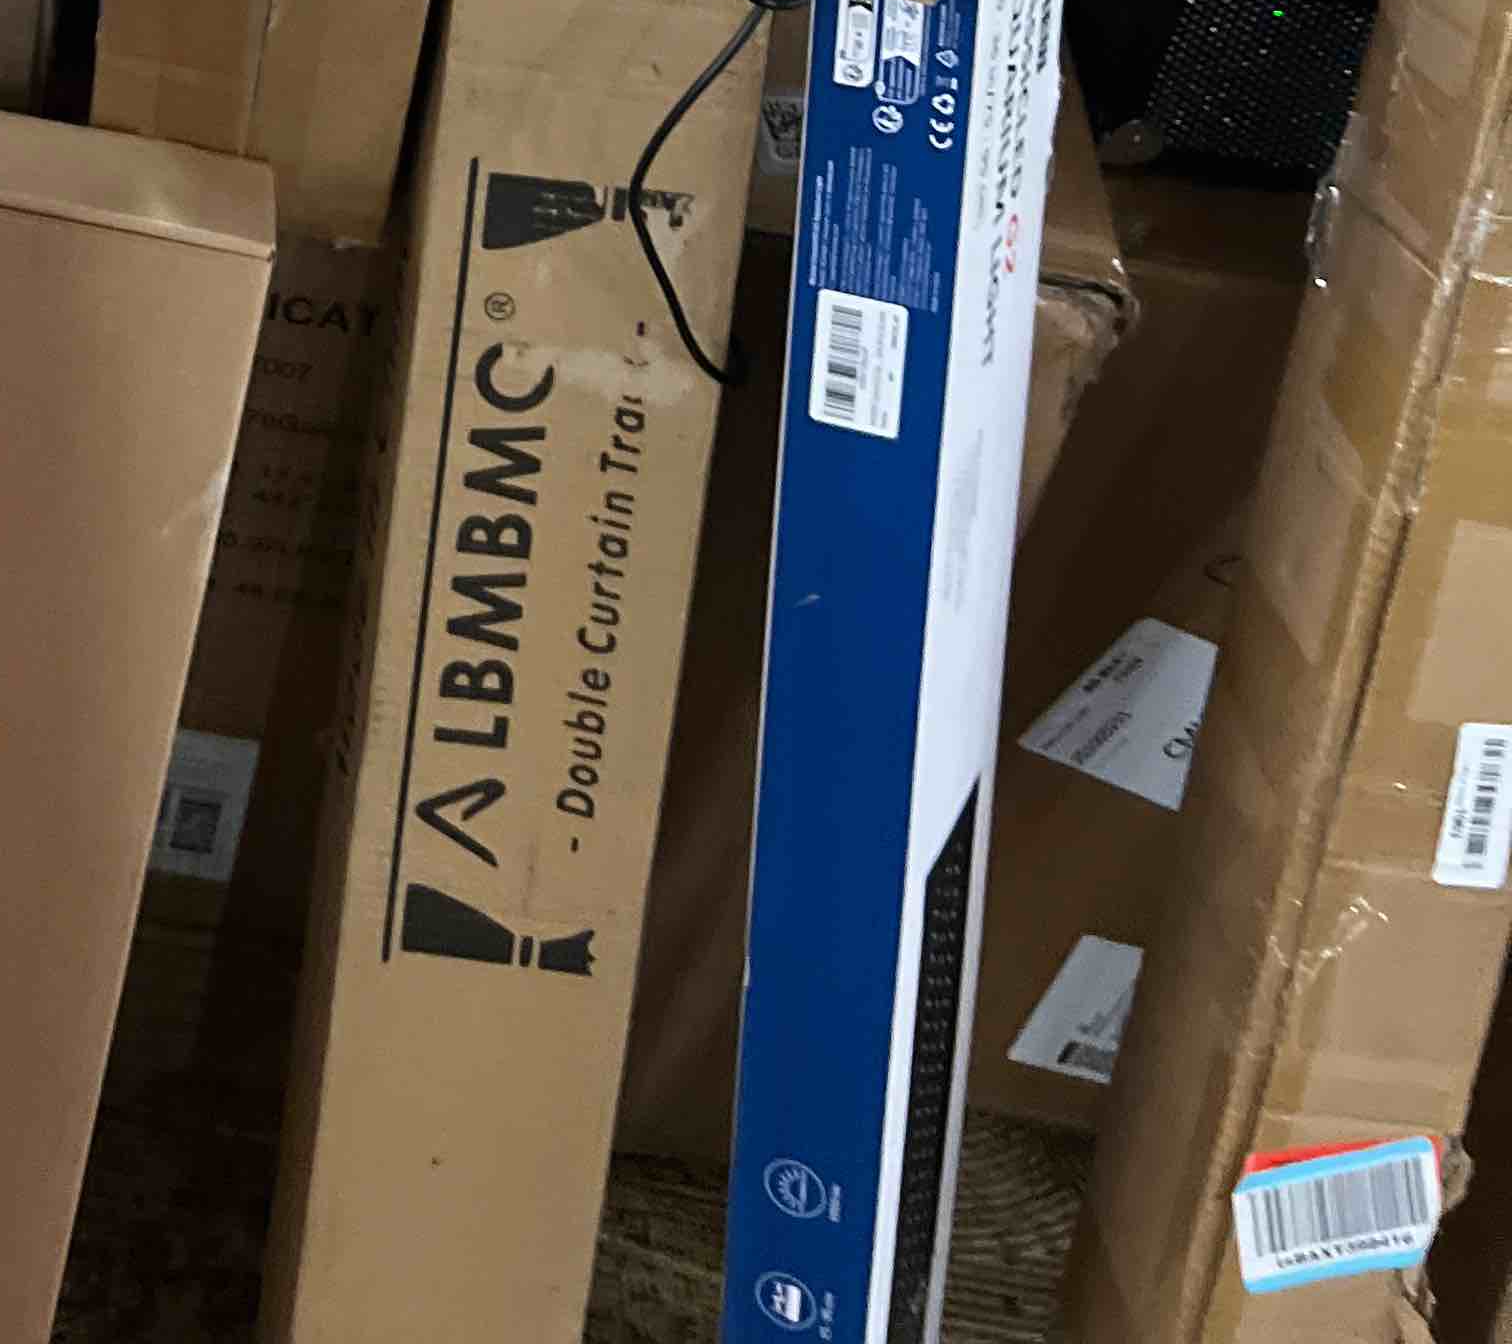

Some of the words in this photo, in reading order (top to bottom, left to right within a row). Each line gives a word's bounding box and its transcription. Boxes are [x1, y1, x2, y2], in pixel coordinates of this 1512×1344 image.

[414, 341, 556, 869] ALBMBMC
[578, 488, 636, 655] Curtain
[556, 664, 614, 816] Double
